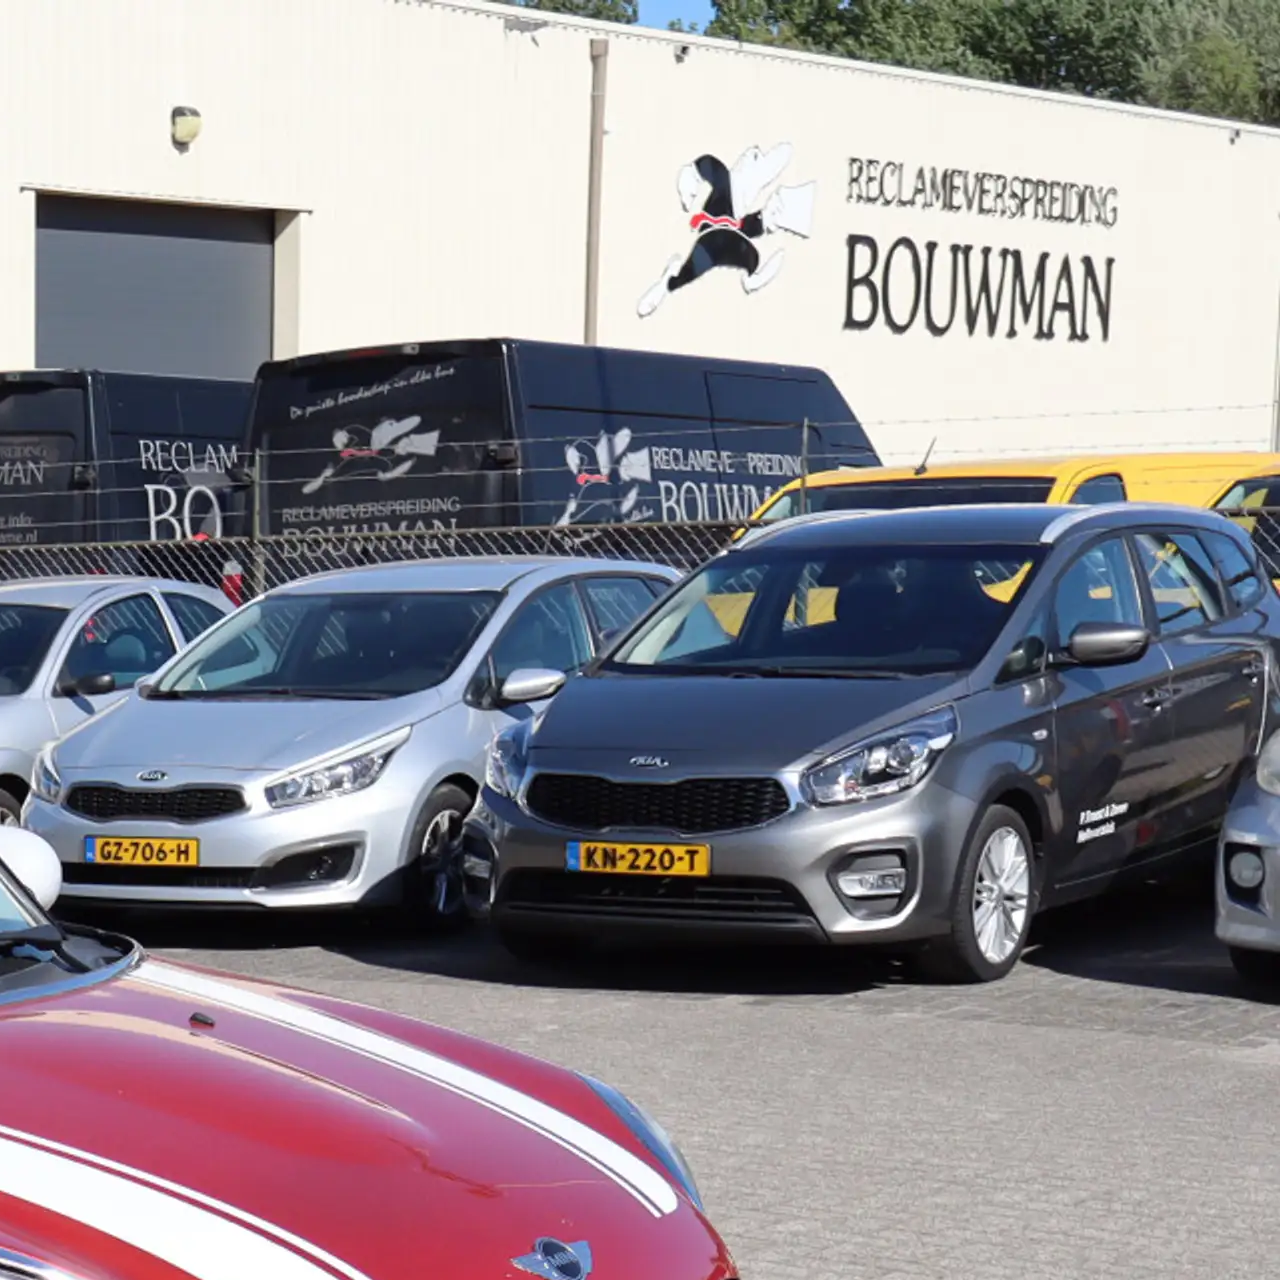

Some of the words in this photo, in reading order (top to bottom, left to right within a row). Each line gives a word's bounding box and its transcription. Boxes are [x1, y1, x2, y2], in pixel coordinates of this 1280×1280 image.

[846, 156, 1118, 229] RECLAMEVERSPREIDING
[842, 233, 1116, 343] BOUWMAN
[282, 496, 462, 523] RECLAMEVERSPREIDING
[100, 841, 190, 863] GZ-706-H
[584, 846, 700, 872] KN-220-T
